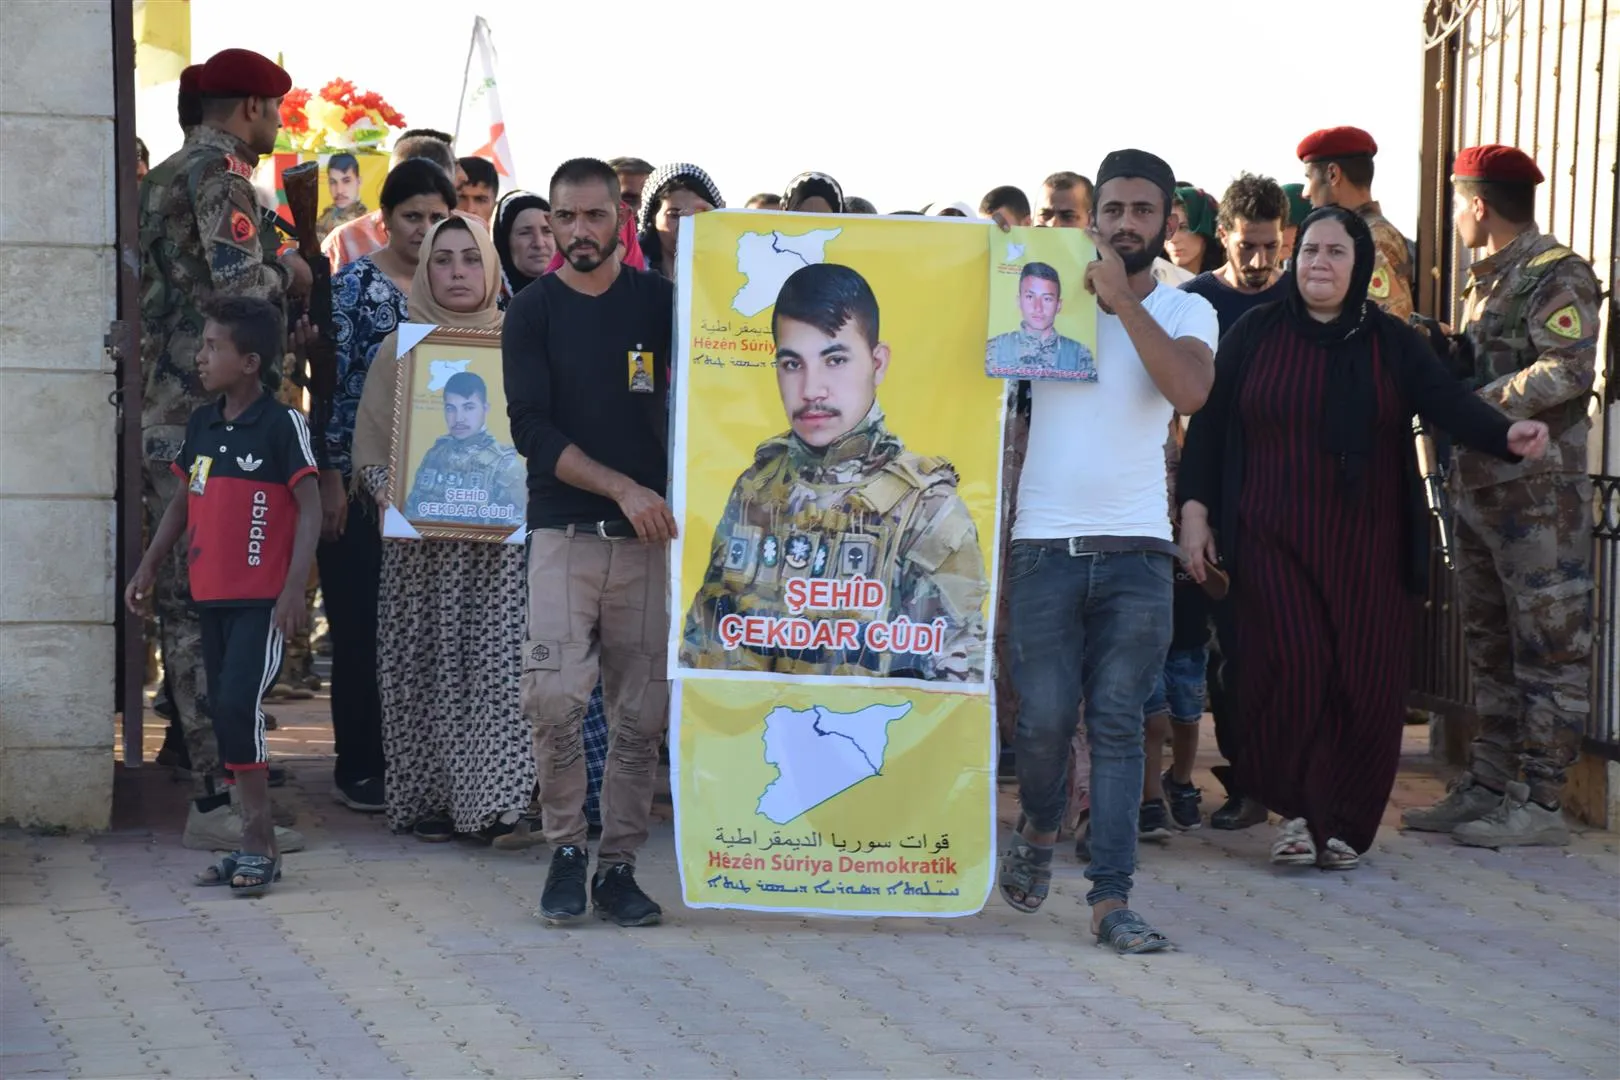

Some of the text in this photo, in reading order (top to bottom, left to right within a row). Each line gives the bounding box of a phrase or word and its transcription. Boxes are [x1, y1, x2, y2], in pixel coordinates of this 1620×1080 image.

[693, 336, 777, 355] Hêzên Sûriy
[419, 503, 476, 517] ÇEKDAR
[248, 491, 268, 566] abidas
[786, 575, 885, 612] ŞEHÎD
[721, 616, 945, 653] ÇEKDAR CÛDÎ
[714, 827, 950, 854] قوات سوريا الديمقراطية
[708, 850, 957, 876] Hêzên Sûriya Demokratîk
